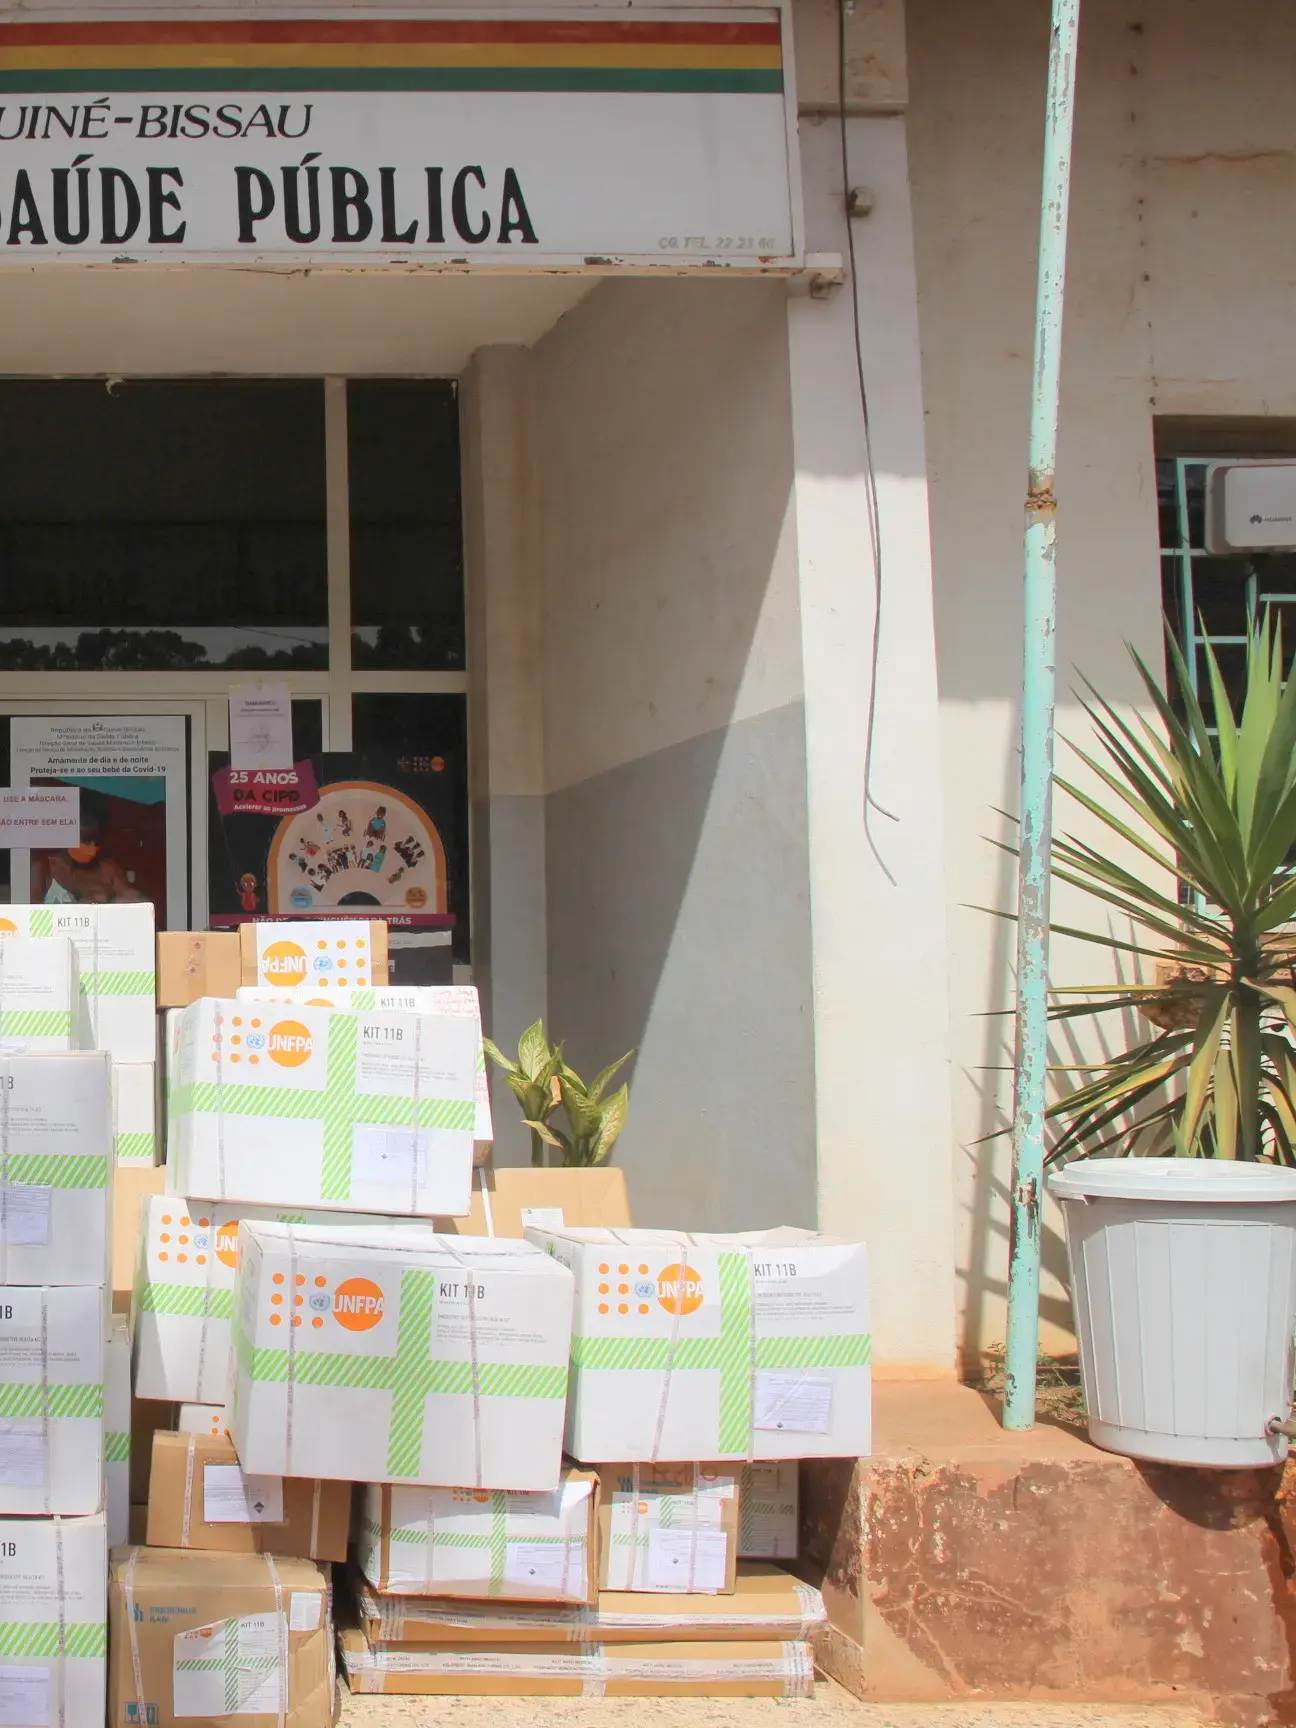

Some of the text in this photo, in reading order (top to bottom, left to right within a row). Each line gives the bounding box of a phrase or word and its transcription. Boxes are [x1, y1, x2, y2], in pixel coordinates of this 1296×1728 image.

[234, 153, 541, 245] PÚBLICA
[30, 766, 69, 774] Proteja-se
[229, 771, 299, 785] 25 ANOS
[3, 795, 19, 803] USE
[233, 789, 257, 802] DA
[57, 917, 91, 928] KIT 11B
[387, 915, 412, 924] TRÁS
[261, 955, 308, 973] UNFPA
[380, 998, 415, 1008] KIT 11B
[363, 1025, 403, 1041] KIT 11B
[267, 1034, 313, 1052] UNFPA
[754, 1263, 797, 1277] KIT 11B
[439, 1282, 459, 1297] KIT
[332, 1294, 386, 1314] UNFPA
